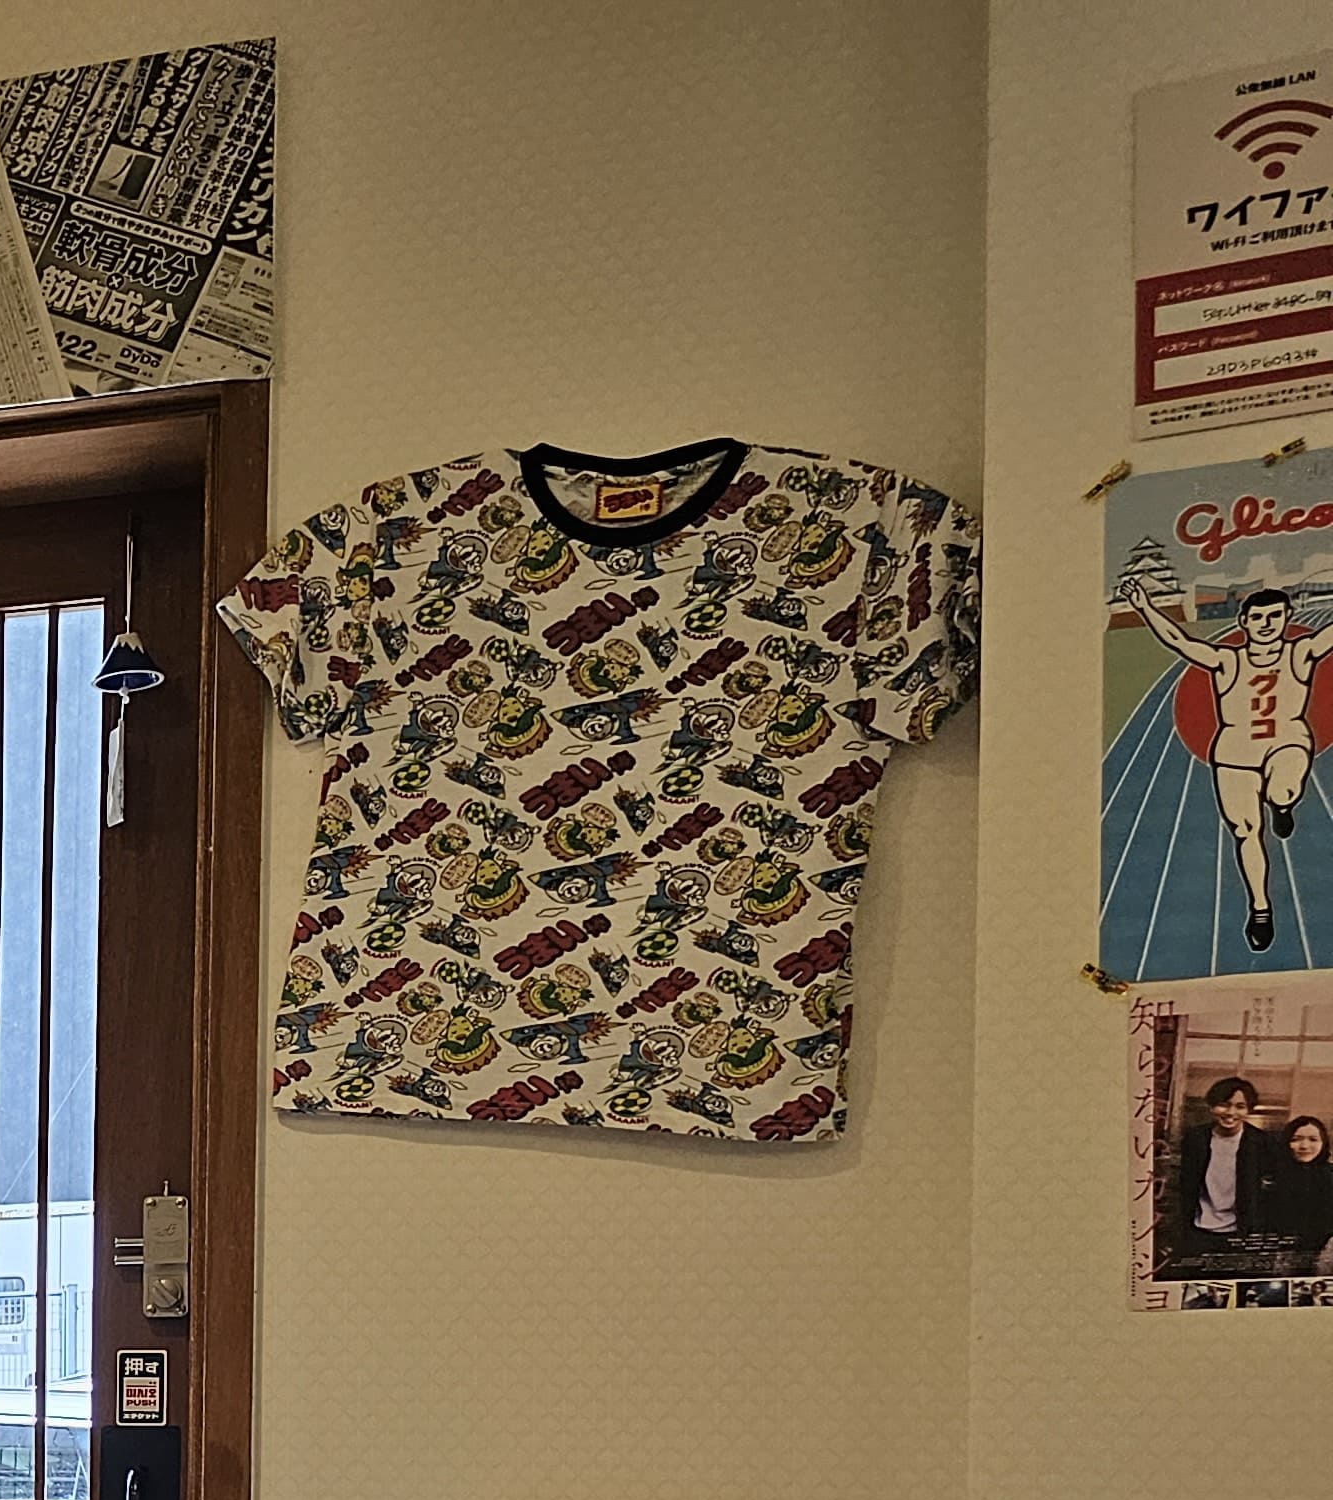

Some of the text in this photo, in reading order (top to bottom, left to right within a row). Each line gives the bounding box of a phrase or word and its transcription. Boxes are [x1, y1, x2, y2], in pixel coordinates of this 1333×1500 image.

[1289, 70, 1316, 85] LAN
[1187, 186, 1333, 232] ワイファ
[51, 220, 198, 296] 軟骨成分
[41, 265, 179, 341] 筋肉成分
[120, 348, 161, 369] DyDo
[1248, 669, 1281, 741] グリコ
[124, 1357, 160, 1376] 押す
[126, 1388, 157, 1398] 미시오
[126, 1399, 157, 1407] PUSH
